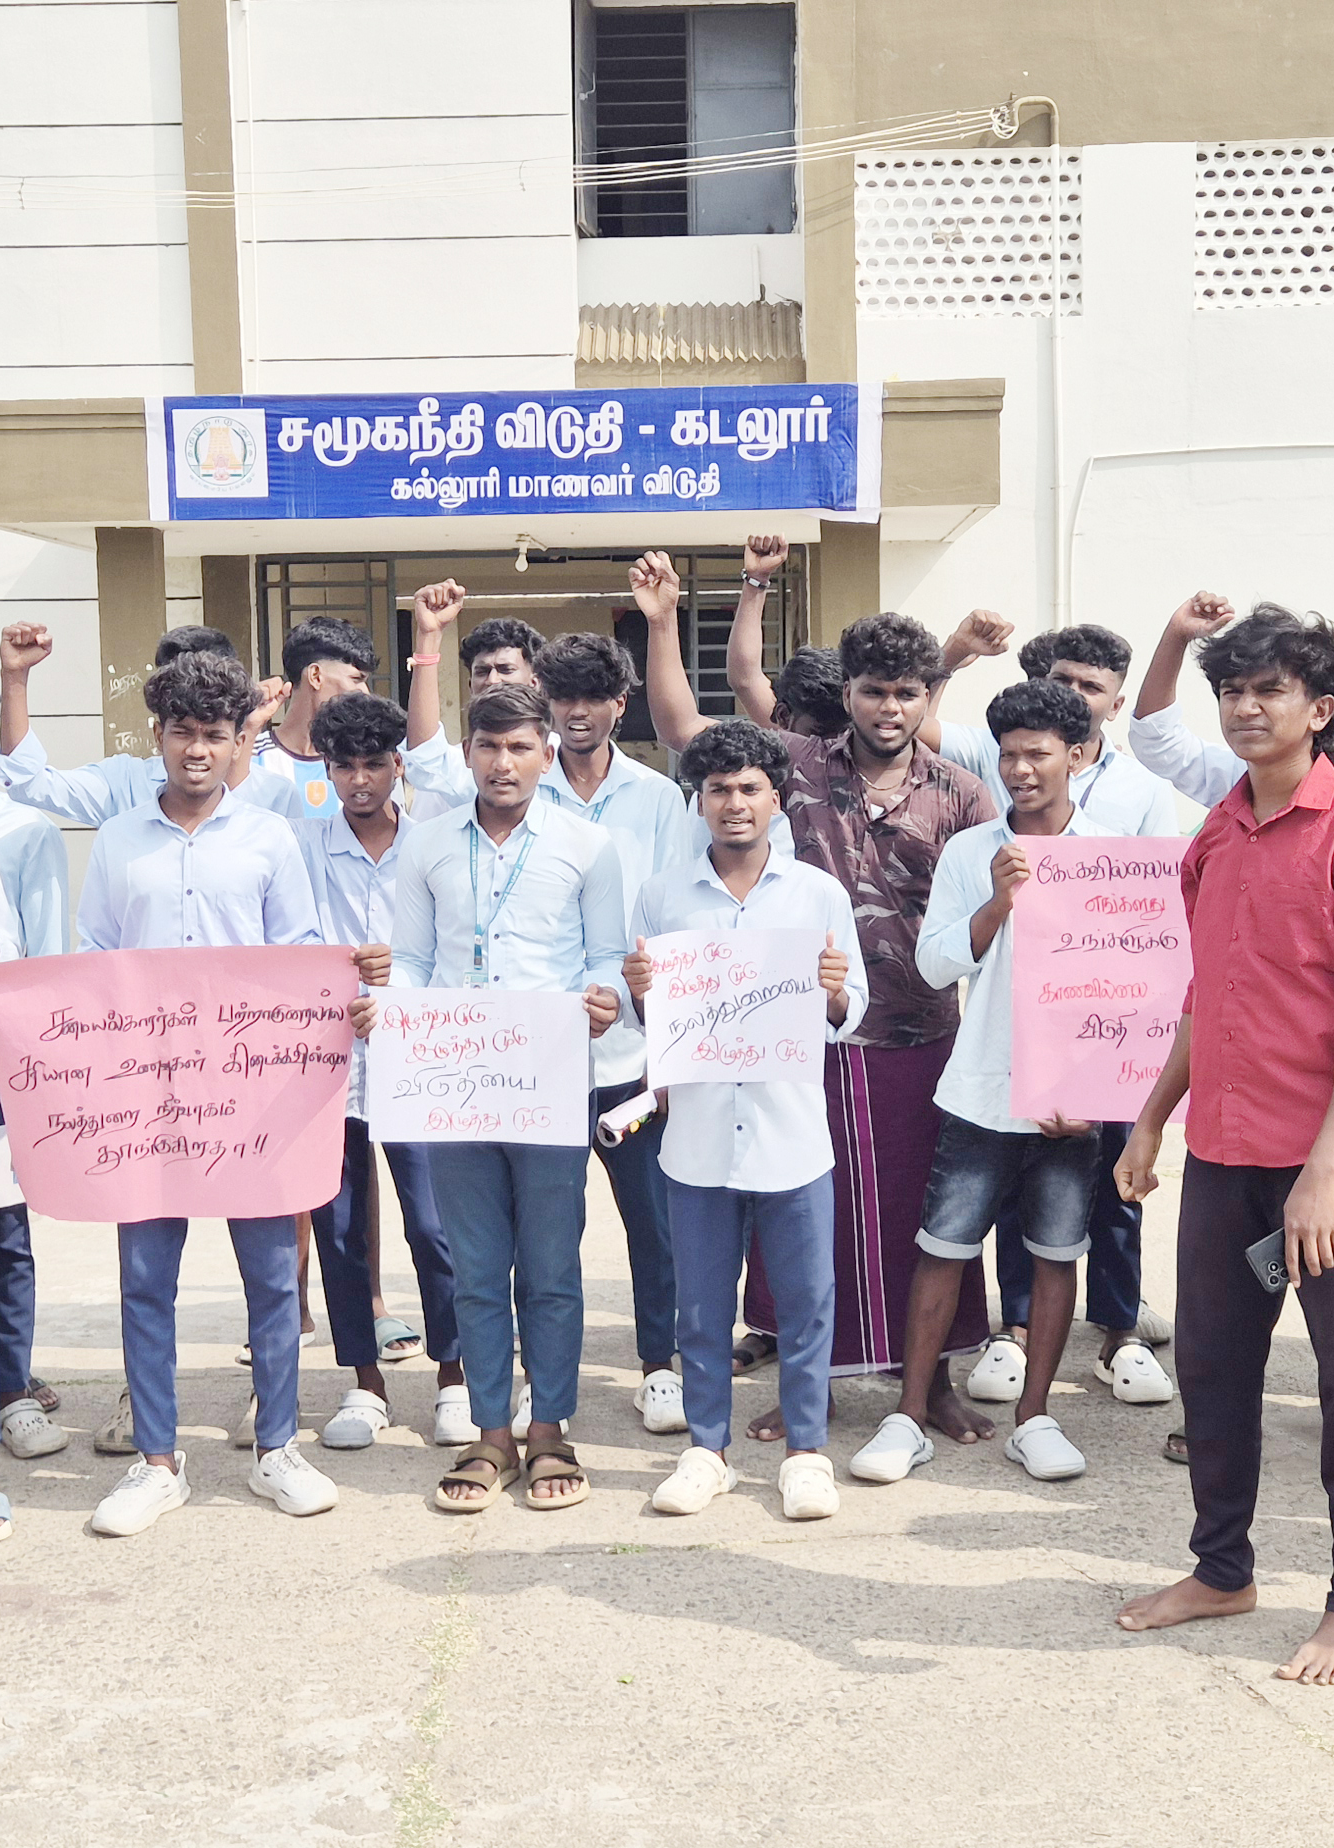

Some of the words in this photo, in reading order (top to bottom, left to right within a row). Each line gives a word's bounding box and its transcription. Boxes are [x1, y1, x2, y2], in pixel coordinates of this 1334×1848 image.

[276, 397, 484, 465] சமூகநீதி
[496, 401, 623, 461] விடுதி
[670, 395, 832, 461] கடலூர்
[391, 466, 500, 509] கல்லூரி
[508, 463, 635, 498] மாணவர்
[642, 463, 720, 501] விடுதி
[1037, 855, 1179, 884] கேட்கவில்லைய
[1051, 924, 1179, 954] உங்களுக்கு
[39, 1002, 198, 1041] சமையல்காரர்கள்
[658, 976, 815, 1064] நலத்துறையை
[1075, 1008, 1138, 1049] விடுதி
[9, 1055, 92, 1091] சரியான
[103, 1049, 206, 1082] உணவுகள்
[392, 1063, 537, 1109] விடுதியை
[33, 1107, 140, 1148] நலத்துறை
[145, 1093, 236, 1129] நிர்வாகம்
